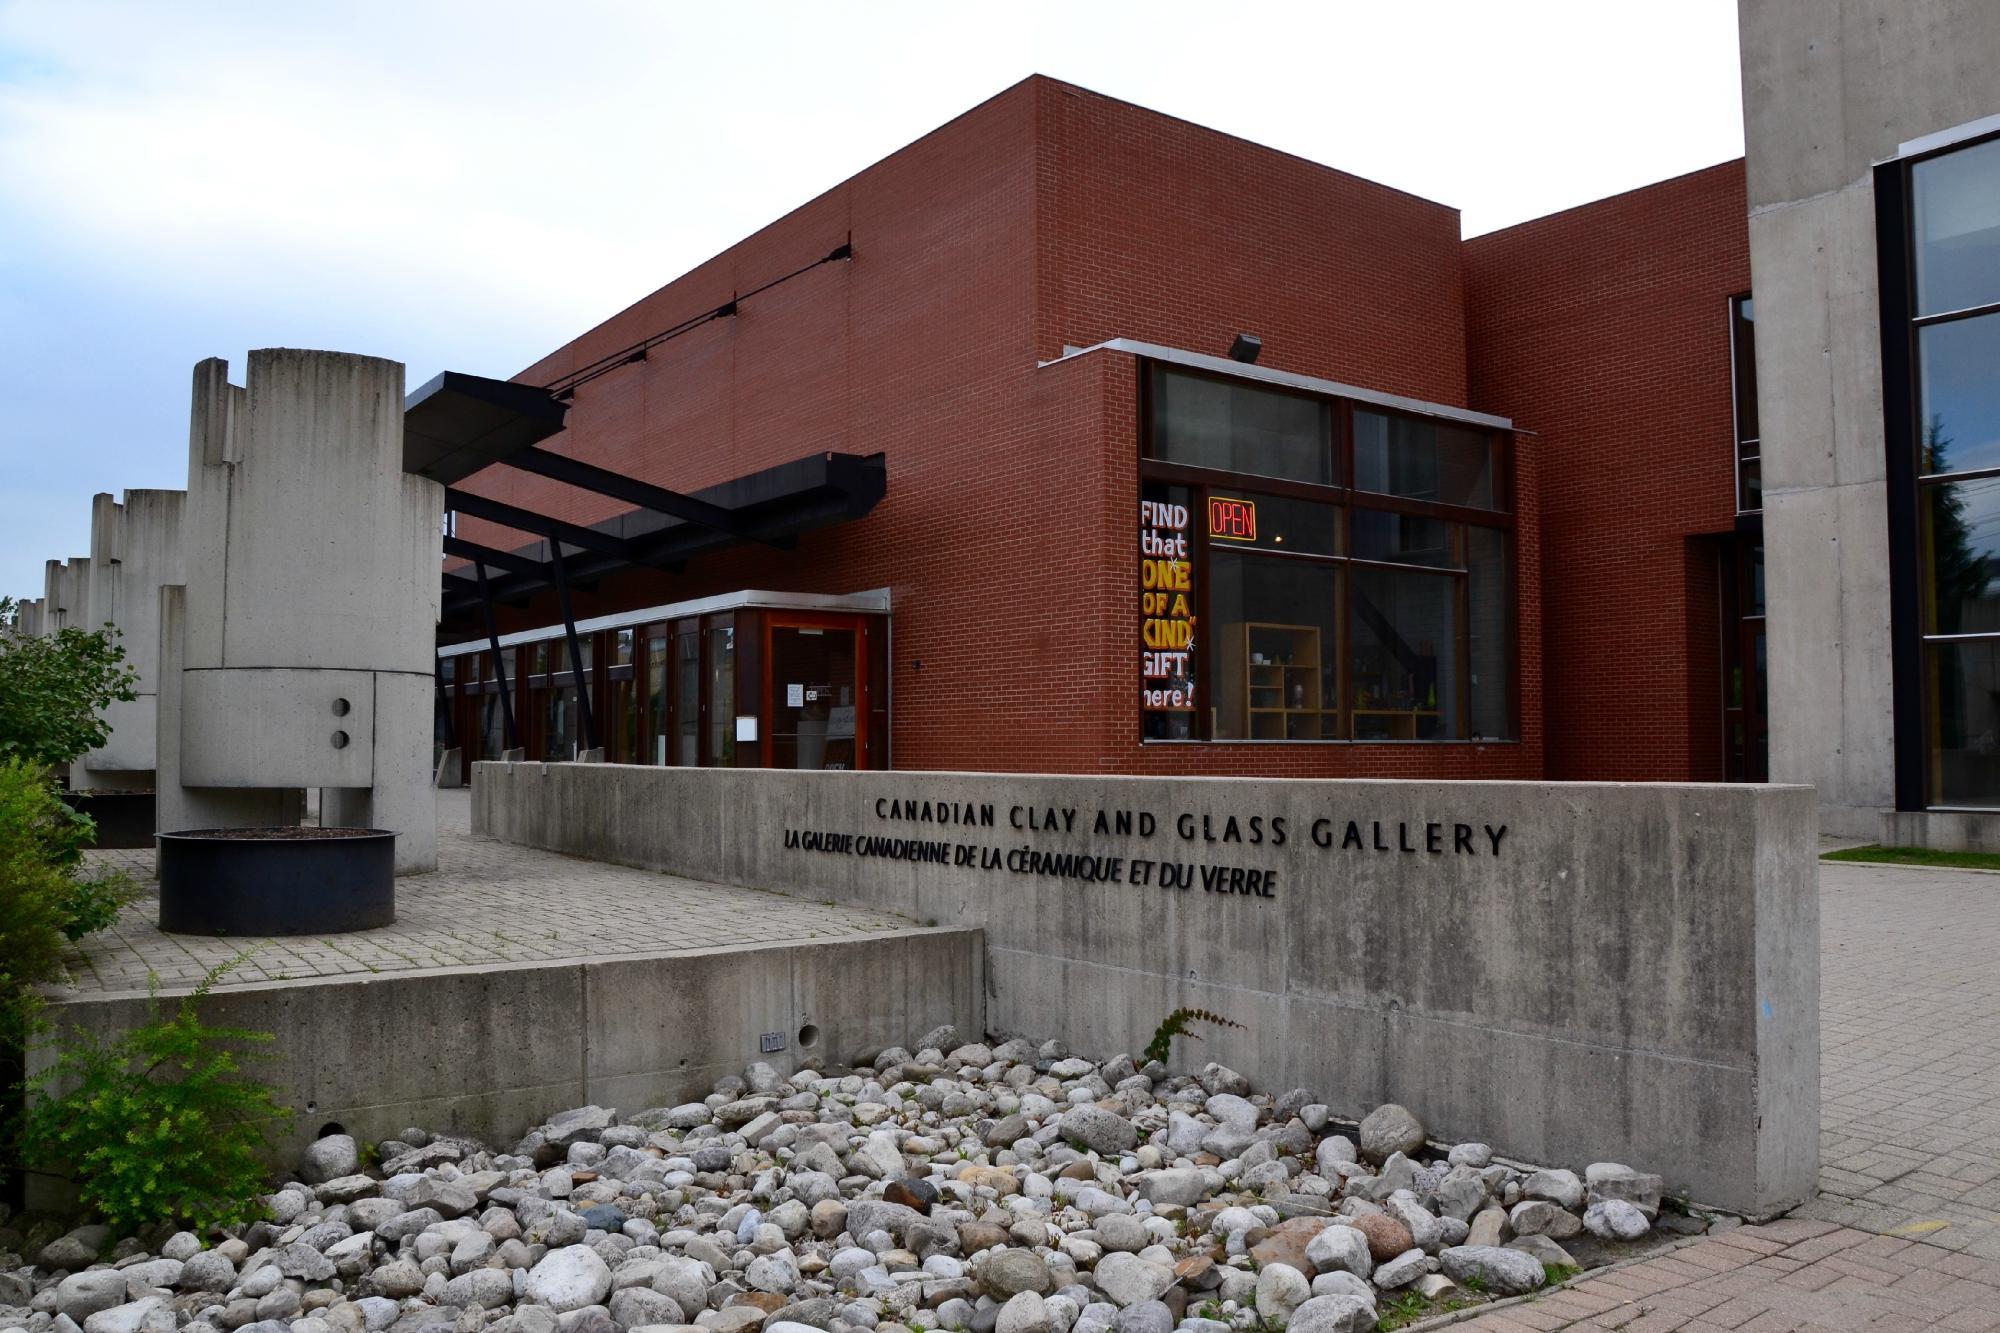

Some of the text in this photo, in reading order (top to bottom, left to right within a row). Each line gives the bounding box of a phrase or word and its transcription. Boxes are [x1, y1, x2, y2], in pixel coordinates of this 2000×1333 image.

[1141, 500, 1188, 529] FIND
[1211, 501, 1253, 537] OPEN
[1142, 529, 1187, 557] that
[1143, 559, 1192, 591] ONE
[1143, 592, 1190, 618] OF A
[875, 798, 1507, 857] CANADIAN CLAY AND GLASS GALLERY
[784, 829, 1278, 898] LA GALERIE CANADIENNE DE LA CÉRAMIQUE ET DU VERRE
